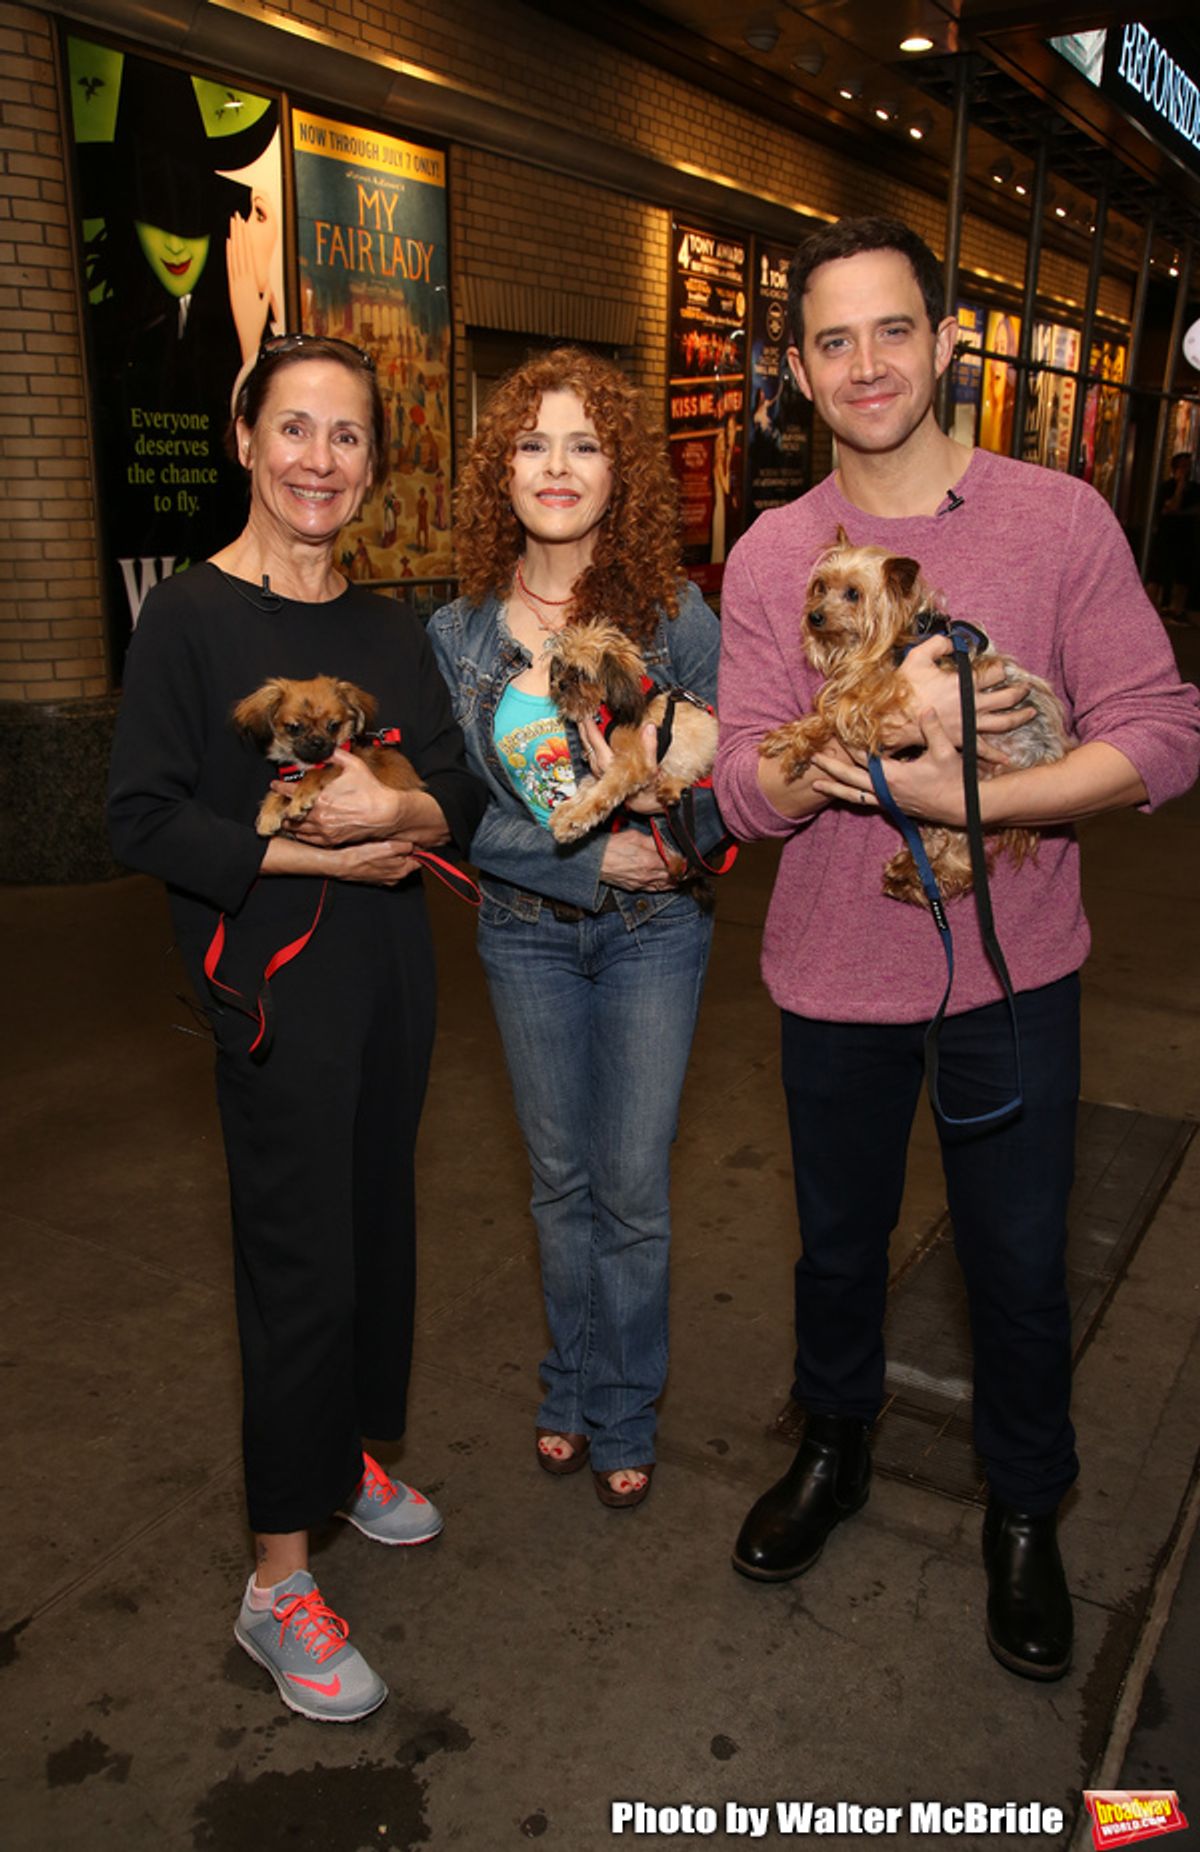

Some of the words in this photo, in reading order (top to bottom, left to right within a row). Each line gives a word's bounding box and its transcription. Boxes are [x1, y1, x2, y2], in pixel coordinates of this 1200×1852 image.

[299, 123, 326, 148] NOW
[329, 131, 379, 161] THROUGH
[382, 147, 403, 168] JULY
[406, 154, 411, 170] 7
[414, 155, 440, 178] ONLY!
[357, 184, 398, 232] MY
[314, 220, 375, 274] FAIR
[379, 233, 434, 283] LADY
[678, 233, 690, 269] 4
[690, 234, 715, 256] TONY
[672, 396, 697, 419] KISS
[131, 408, 209, 434] Everyone
[135, 434, 209, 456] deserves
[127, 463, 155, 484] the
[160, 463, 218, 484] chance
[154, 495, 171, 512] to
[177, 490, 200, 516] fly.
